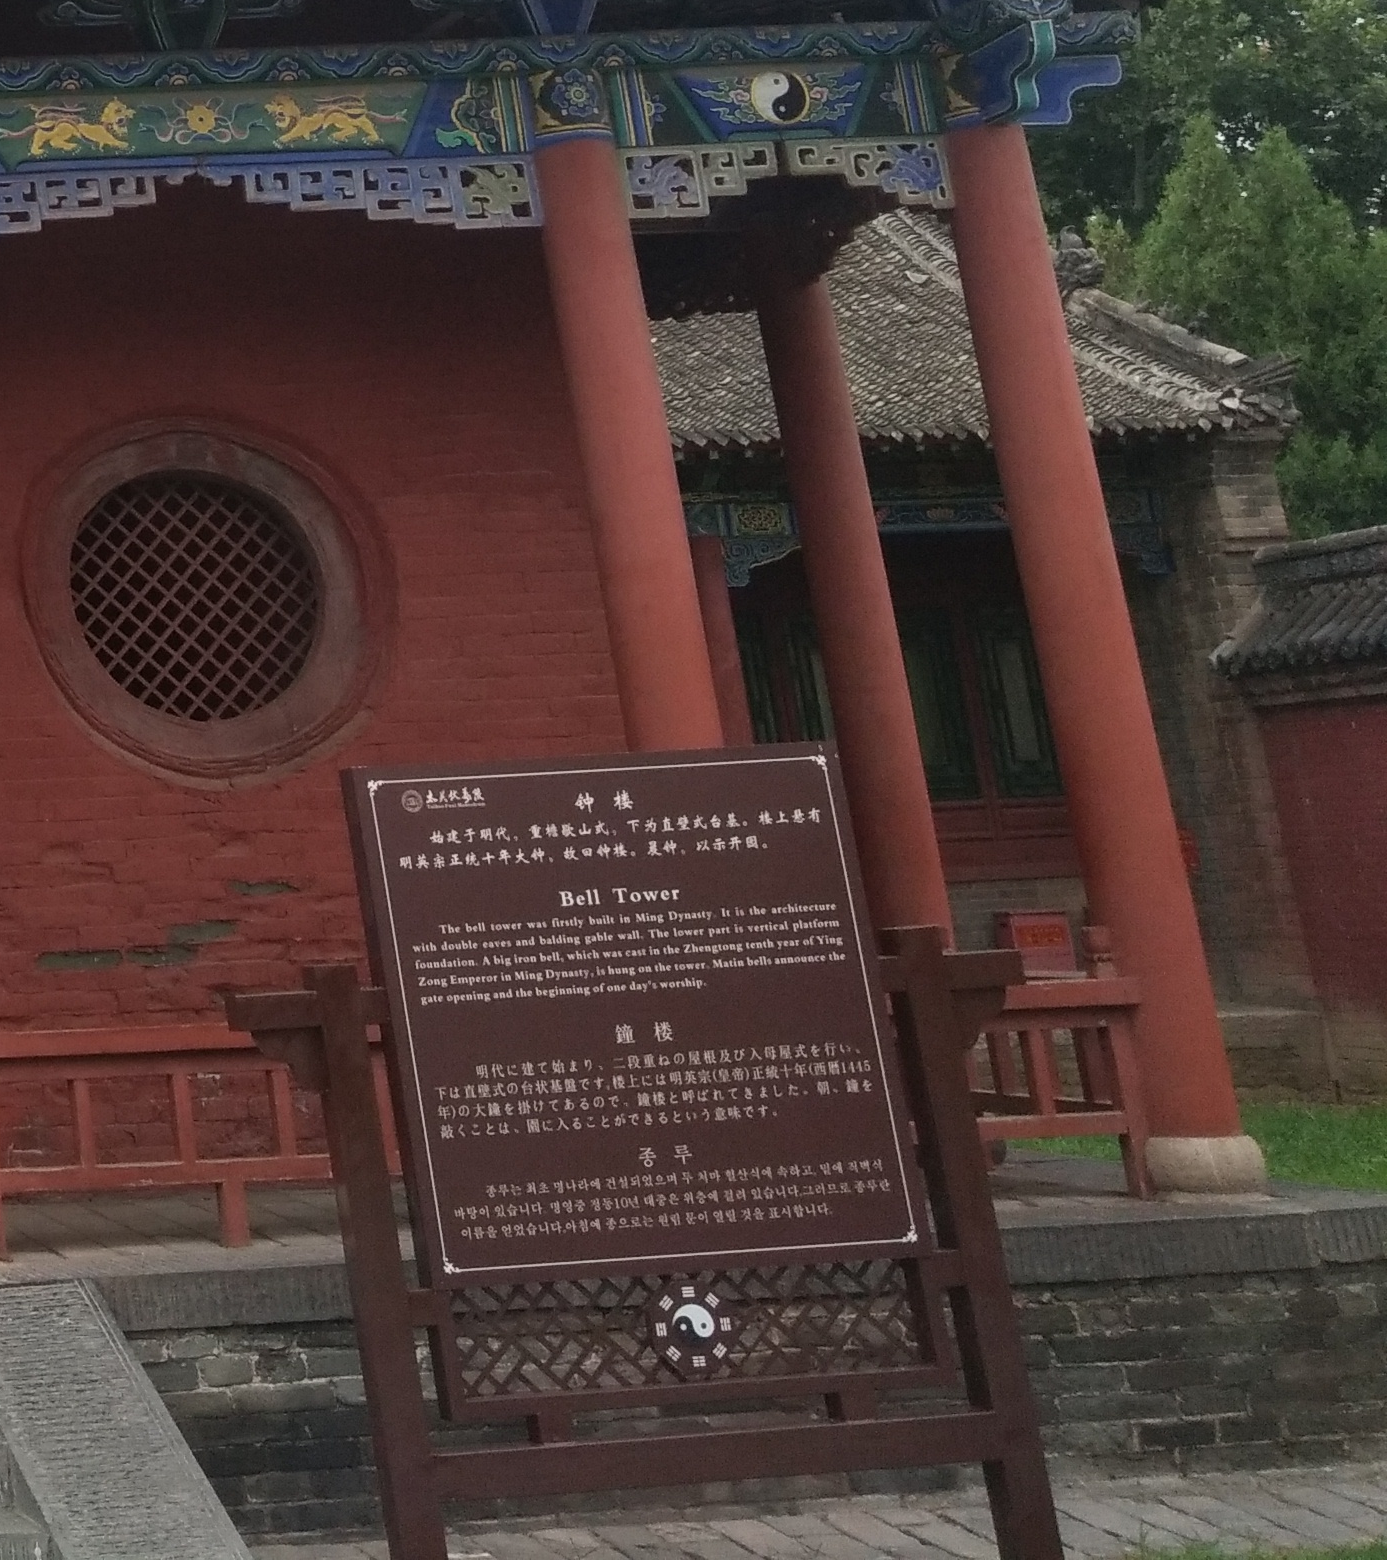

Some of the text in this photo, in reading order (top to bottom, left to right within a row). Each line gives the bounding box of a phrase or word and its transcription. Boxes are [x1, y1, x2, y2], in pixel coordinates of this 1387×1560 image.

[573, 789, 634, 814] 钟楼
[558, 887, 680, 907] Bell Tower
[438, 923, 461, 935] The
[464, 921, 486, 933] bell
[490, 922, 522, 932] tower
[526, 921, 548, 929] was
[551, 916, 584, 929] firstly
[588, 914, 615, 926] built
[619, 913, 631, 924] in
[635, 912, 665, 924] Ming
[721, 907, 731, 918] It
[734, 906, 745, 917] is
[748, 905, 767, 916] the
[770, 903, 837, 914] architecture
[412, 941, 437, 953] with
[440, 939, 478, 951] double
[482, 940, 512, 949] eaves
[515, 936, 536, 947] and
[538, 934, 581, 946] balding
[584, 931, 614, 945] gable
[647, 928, 670, 939] The
[672, 927, 704, 938] lower
[708, 926, 731, 938] part
[733, 923, 744, 934] is
[747, 920, 789, 933] vertical
[792, 918, 840, 933] platform
[482, 955, 491, 966] A
[492, 954, 512, 967] big
[513, 953, 537, 964] iron
[566, 949, 600, 961] which
[602, 950, 623, 958] was
[624, 948, 647, 957] cast
[648, 945, 661, 956] in
[662, 944, 680, 955] the
[682, 943, 744, 954] Zhengtong
[745, 938, 775, 950] tenth
[776, 939, 800, 950] year
[802, 935, 815, 946] of
[816, 934, 844, 946] Ying
[417, 976, 448, 988] Zong
[449, 974, 498, 986] Emperor
[500, 971, 512, 982] in
[514, 970, 544, 982] Ming
[596, 966, 606, 976] is
[607, 965, 636, 977] hung
[637, 965, 653, 973] on
[654, 962, 672, 972] the
[712, 957, 745, 969] Matin
[746, 955, 772, 967] bells
[773, 954, 826, 965] announce
[828, 951, 846, 961] the
[420, 994, 444, 1006] gate
[446, 990, 492, 1005] opening
[492, 988, 513, 999] and
[515, 987, 533, 998] the
[534, 984, 591, 999] beginning
[592, 982, 606, 993] of
[606, 984, 627, 992] one
